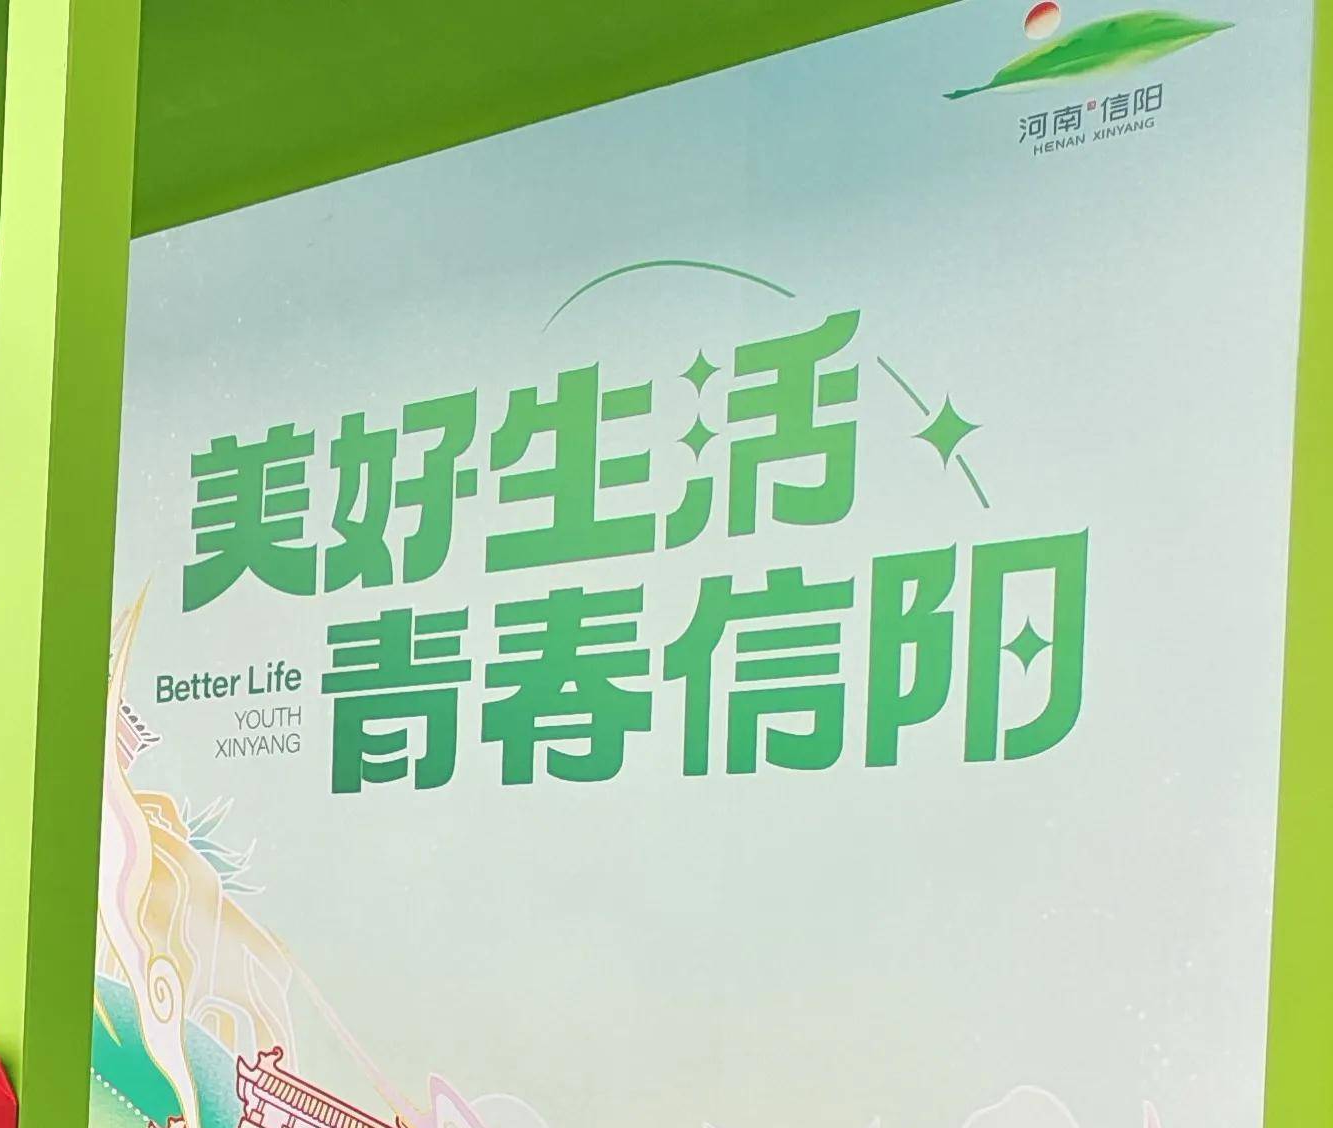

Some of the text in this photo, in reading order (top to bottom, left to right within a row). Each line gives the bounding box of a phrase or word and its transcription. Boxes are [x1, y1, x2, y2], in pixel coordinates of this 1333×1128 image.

[1033, 117, 1155, 155] HENAN XINYANG
[181, 308, 861, 613] 美好生活
[320, 527, 1090, 794] 青春信阳
[156, 660, 302, 704] Better Life
[234, 706, 302, 729] YOUTH
[214, 732, 302, 758] XINYANG
